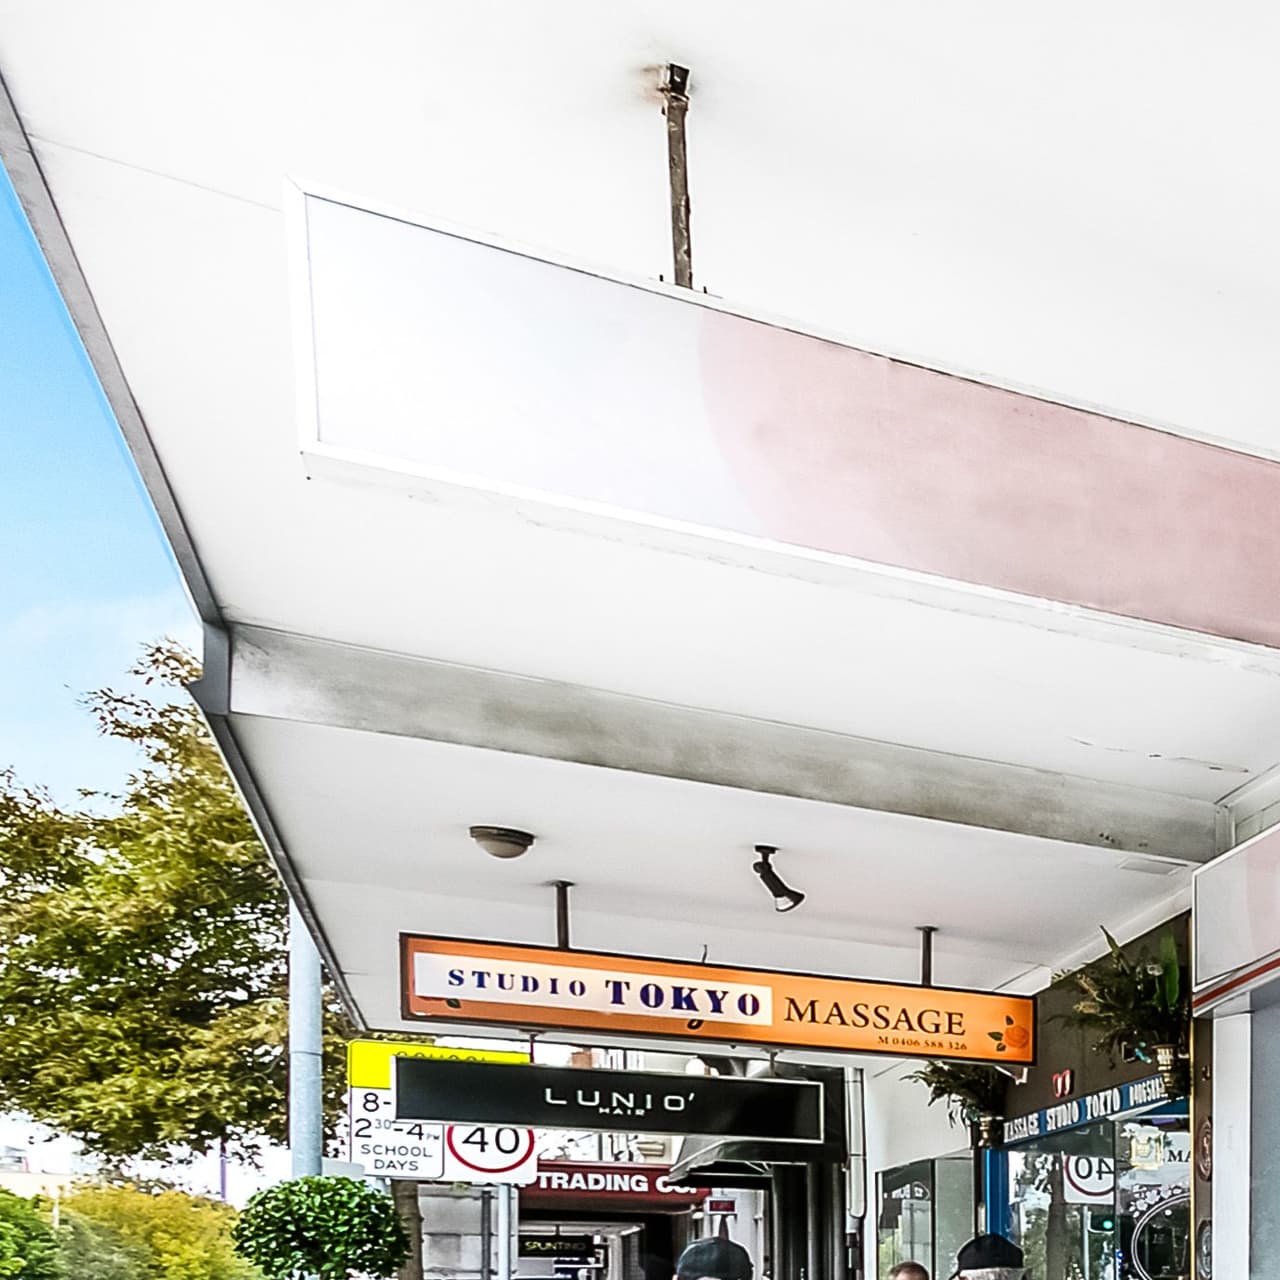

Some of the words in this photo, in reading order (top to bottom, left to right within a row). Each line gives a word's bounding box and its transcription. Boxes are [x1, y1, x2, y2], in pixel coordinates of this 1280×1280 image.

[447, 968, 588, 998] STUDIO
[605, 979, 761, 1017] TOKYO
[784, 996, 966, 1036] MASSAGE
[598, 1107, 646, 1116] HAIR
[461, 1127, 520, 1154] 40
[360, 1143, 433, 1158] SCHOOL
[374, 1159, 419, 1171] DAYS
[537, 1172, 649, 1192] TRADING
